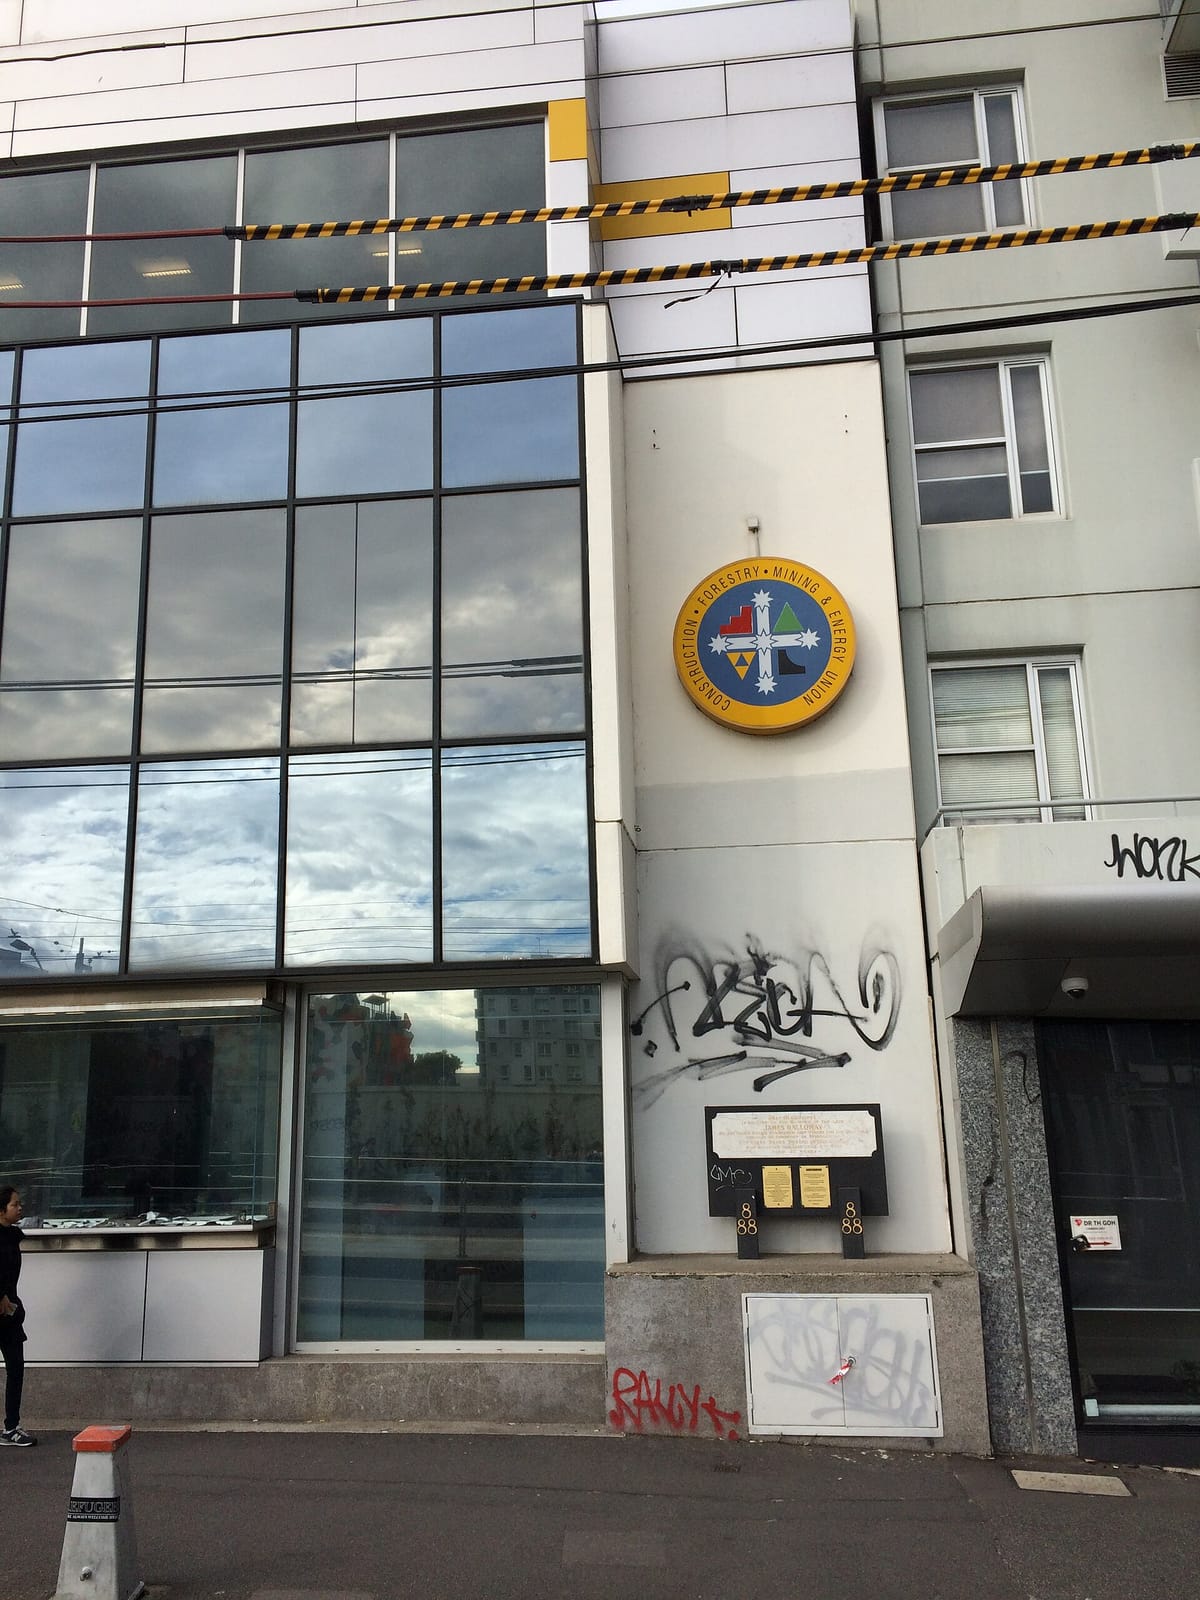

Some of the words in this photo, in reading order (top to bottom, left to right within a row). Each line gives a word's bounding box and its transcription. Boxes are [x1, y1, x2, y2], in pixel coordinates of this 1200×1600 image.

[697, 565, 760, 606] FORESTRY
[772, 565, 820, 594] MINING
[821, 596, 832, 606] &
[829, 610, 847, 664] ENERGY
[682, 618, 731, 712] CONSTRUCTION
[802, 670, 839, 706] UNION
